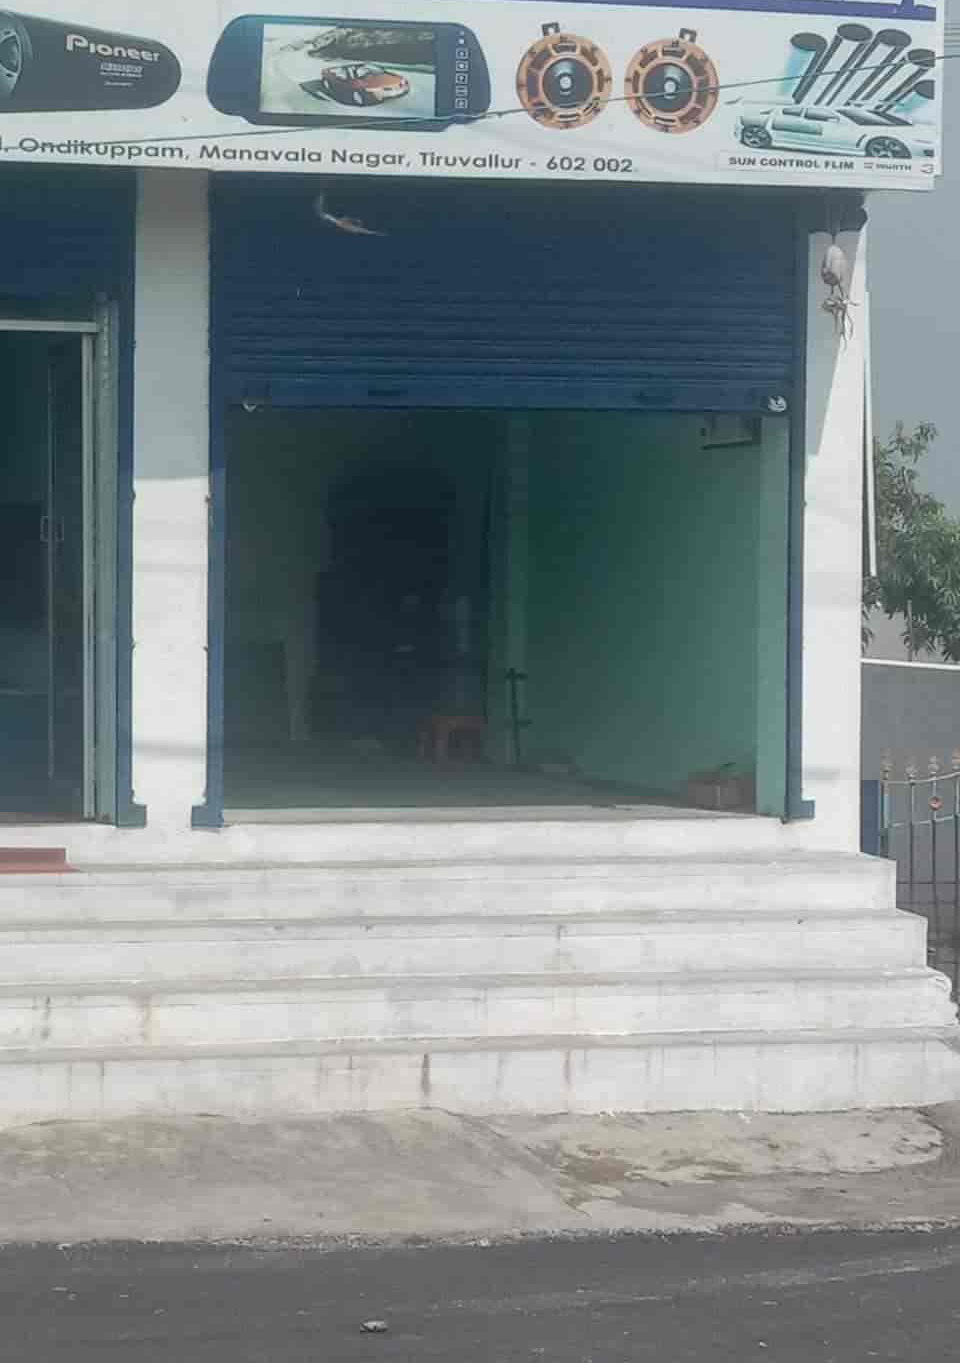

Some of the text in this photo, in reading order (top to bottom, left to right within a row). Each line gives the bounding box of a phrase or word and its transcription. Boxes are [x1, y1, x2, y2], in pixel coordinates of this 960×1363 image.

[65, 34, 160, 62] Pioneer
[18, 136, 191, 160] Ondikuppam,
[199, 143, 322, 164] Manavala
[330, 148, 411, 169] Nagar,
[419, 151, 522, 170] Tiruvallur
[546, 155, 585, 172] 602
[729, 156, 756, 166] SUN
[760, 157, 820, 169] CONTROL
